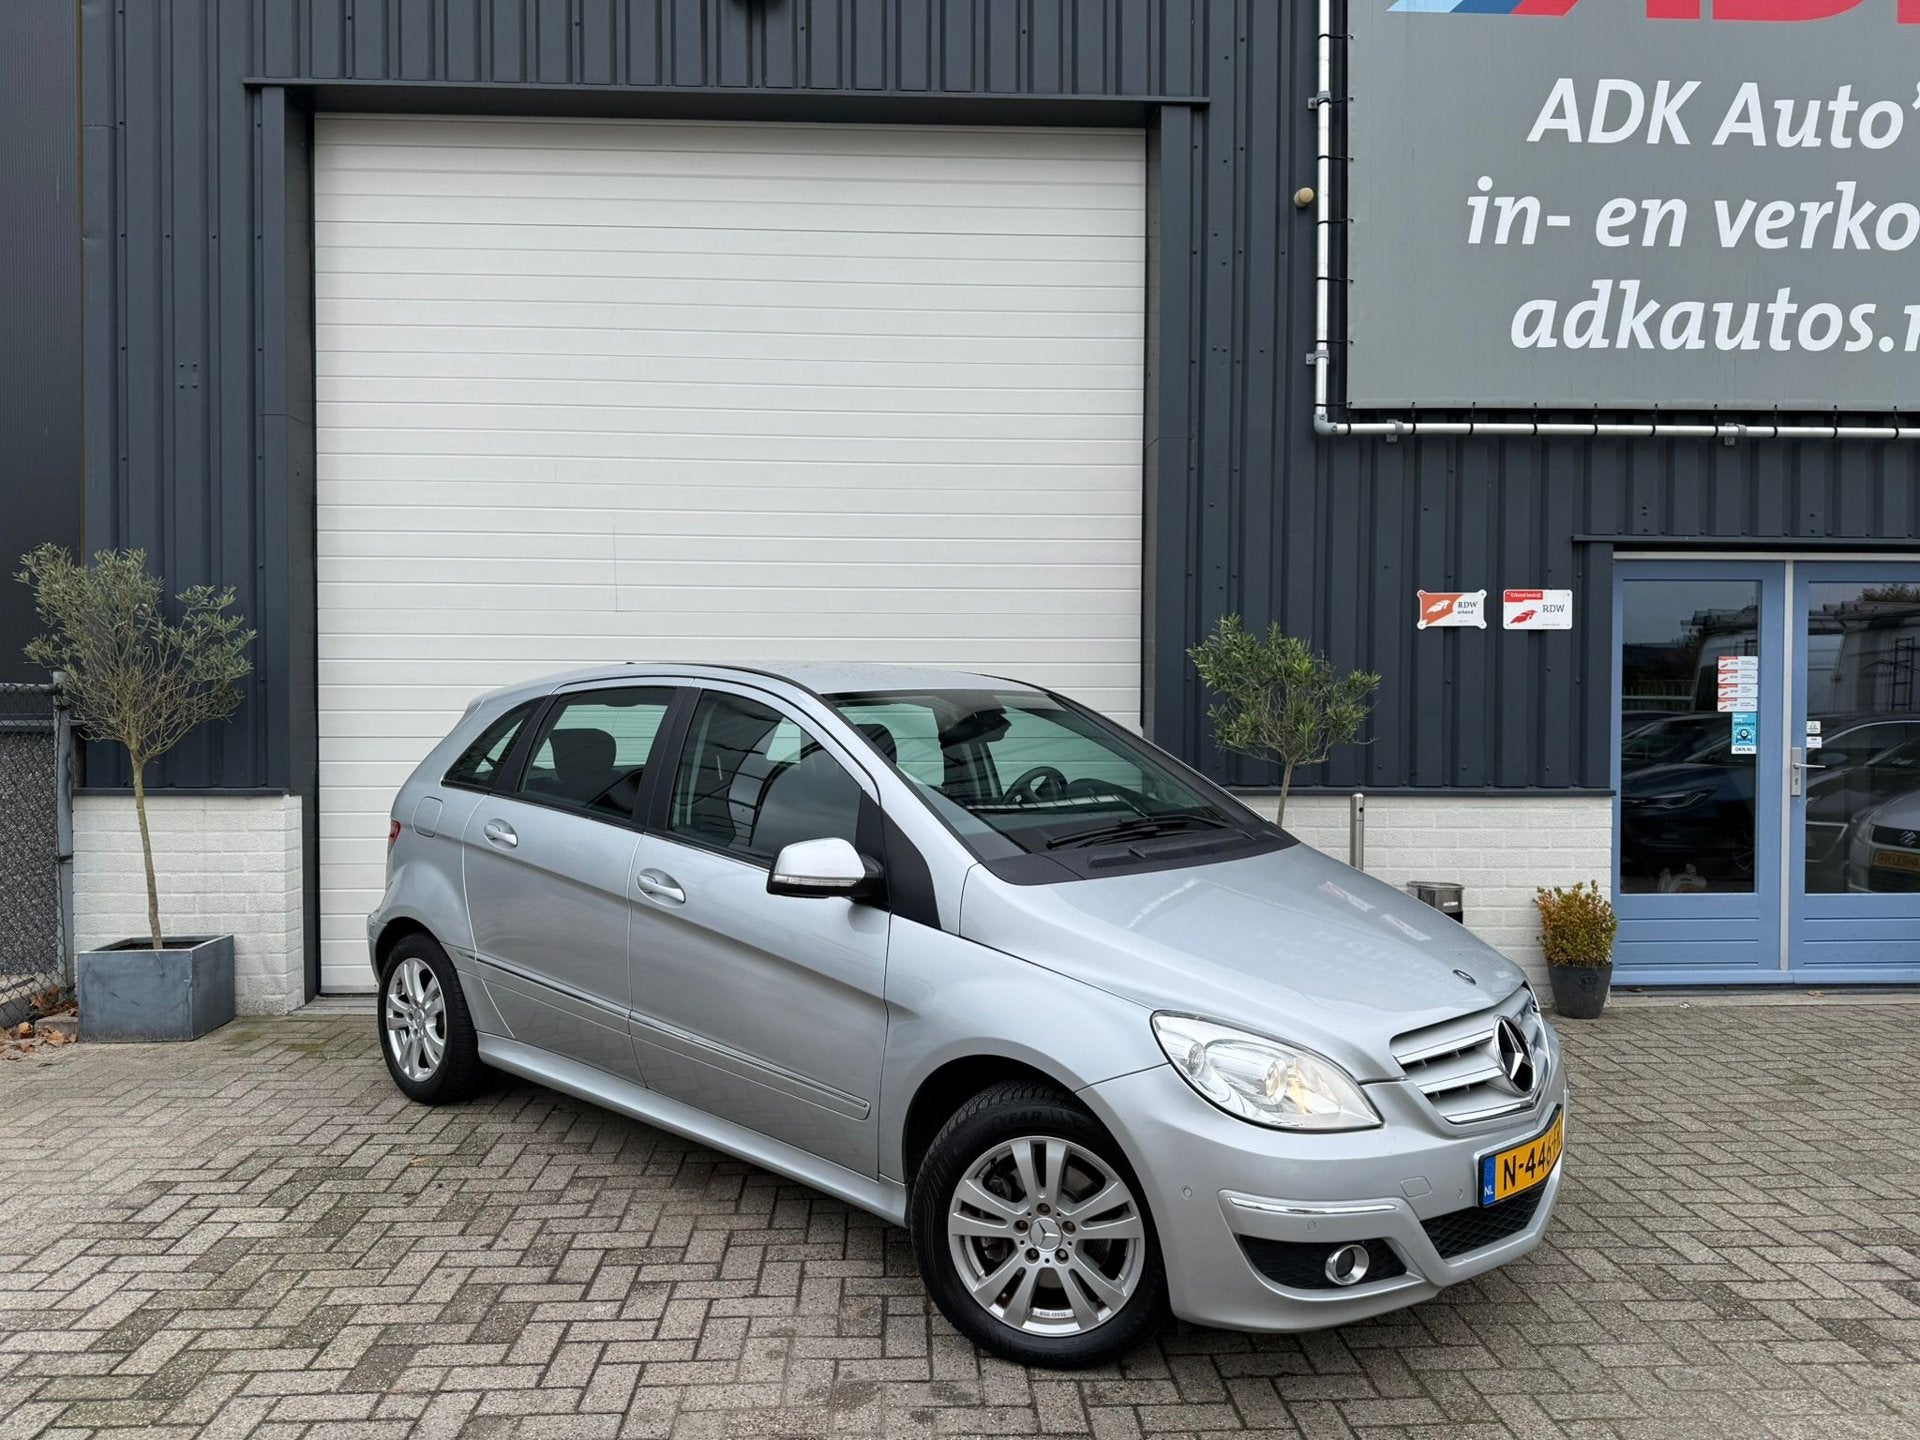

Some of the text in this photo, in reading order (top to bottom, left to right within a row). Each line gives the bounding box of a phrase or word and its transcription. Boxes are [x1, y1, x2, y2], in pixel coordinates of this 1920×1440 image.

[1527, 78, 1702, 145] ADK
[1467, 175, 1920, 251] in- en verko
[1457, 601, 1478, 609] RDW
[1542, 604, 1565, 613] RDW
[1484, 1184, 1494, 1197] NL
